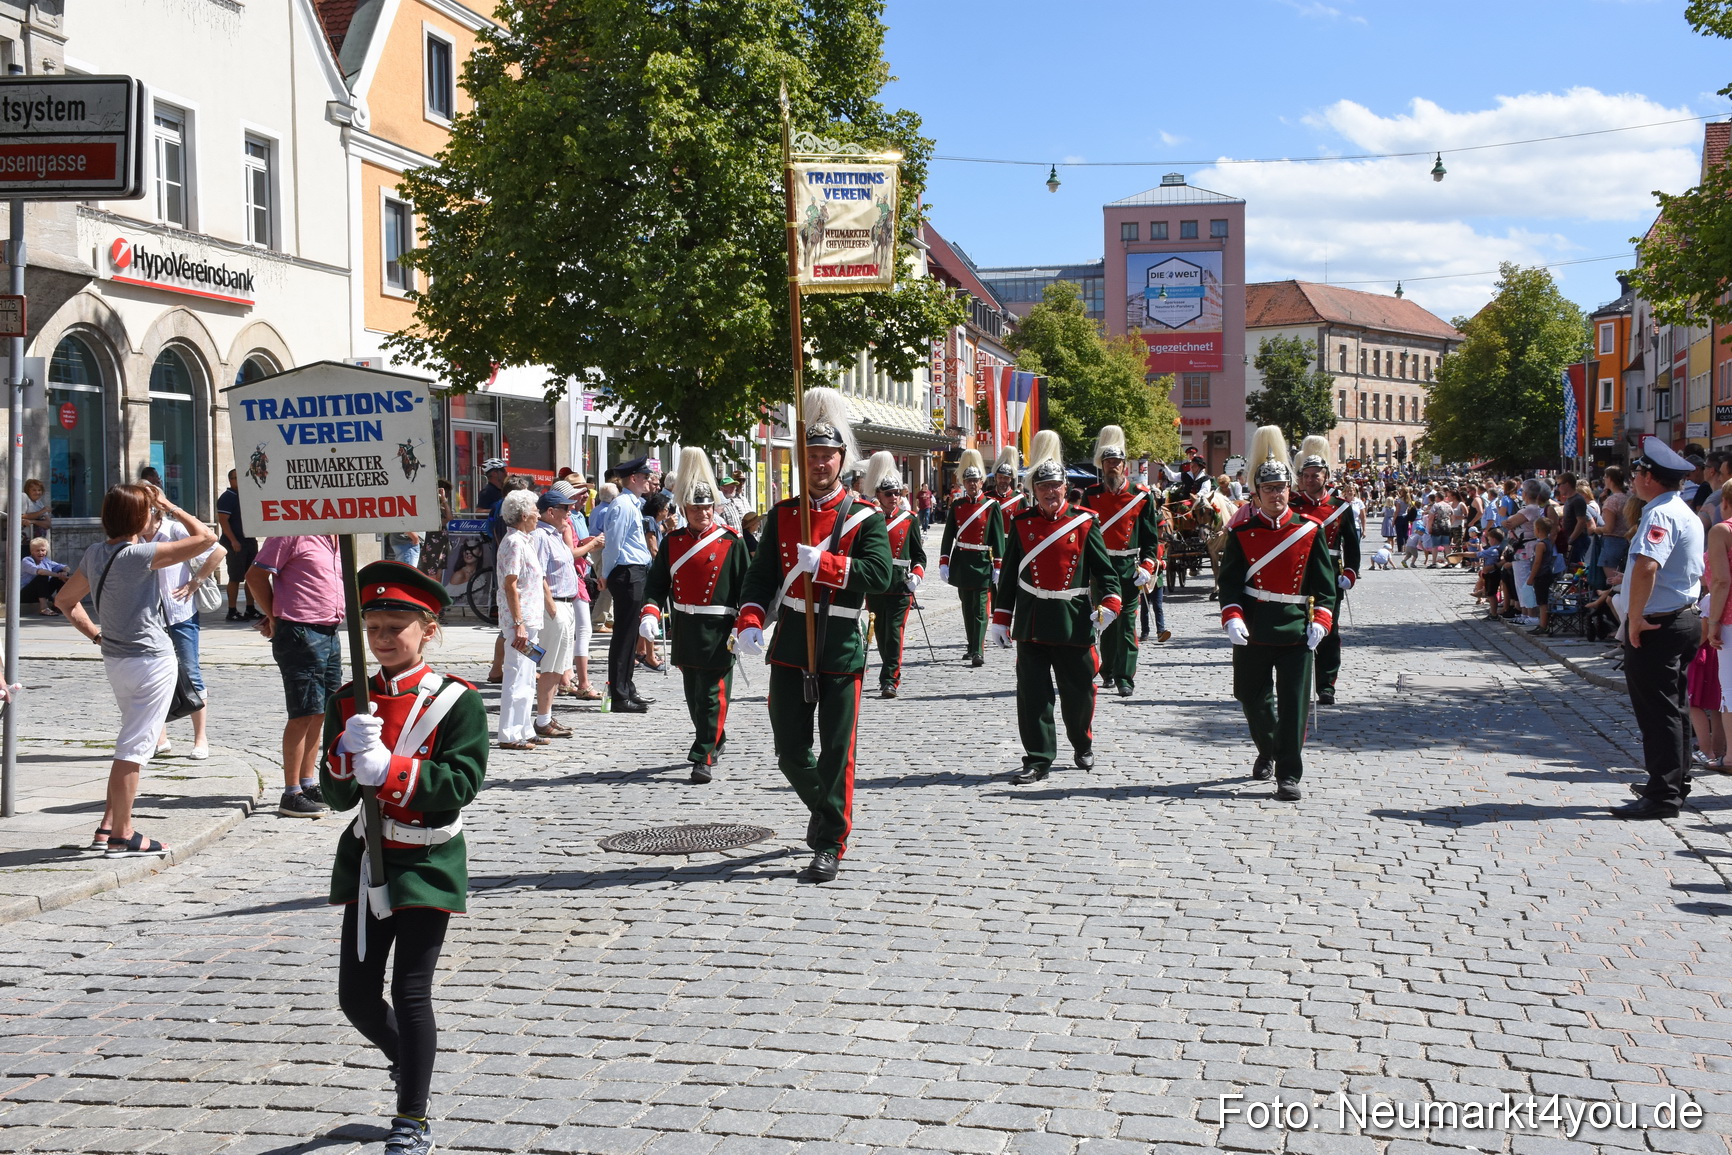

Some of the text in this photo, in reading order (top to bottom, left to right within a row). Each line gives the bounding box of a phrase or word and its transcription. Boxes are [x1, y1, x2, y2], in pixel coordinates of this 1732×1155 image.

[2, 95, 86, 129] tsystem
[806, 171, 889, 185] TRADITIONS-
[823, 187, 872, 201] VEREIN
[825, 229, 870, 239] NEUMARKTER
[133, 244, 255, 292] HypoVereinsbank
[813, 264, 879, 277] ESKADRON
[239, 390, 424, 421] TRADITIONS-
[277, 420, 383, 445] VEREIN
[286, 455, 384, 474] NEUMARKTER
[286, 471, 389, 490] CHEVAULEGERS
[261, 495, 418, 522] ESKADRON
